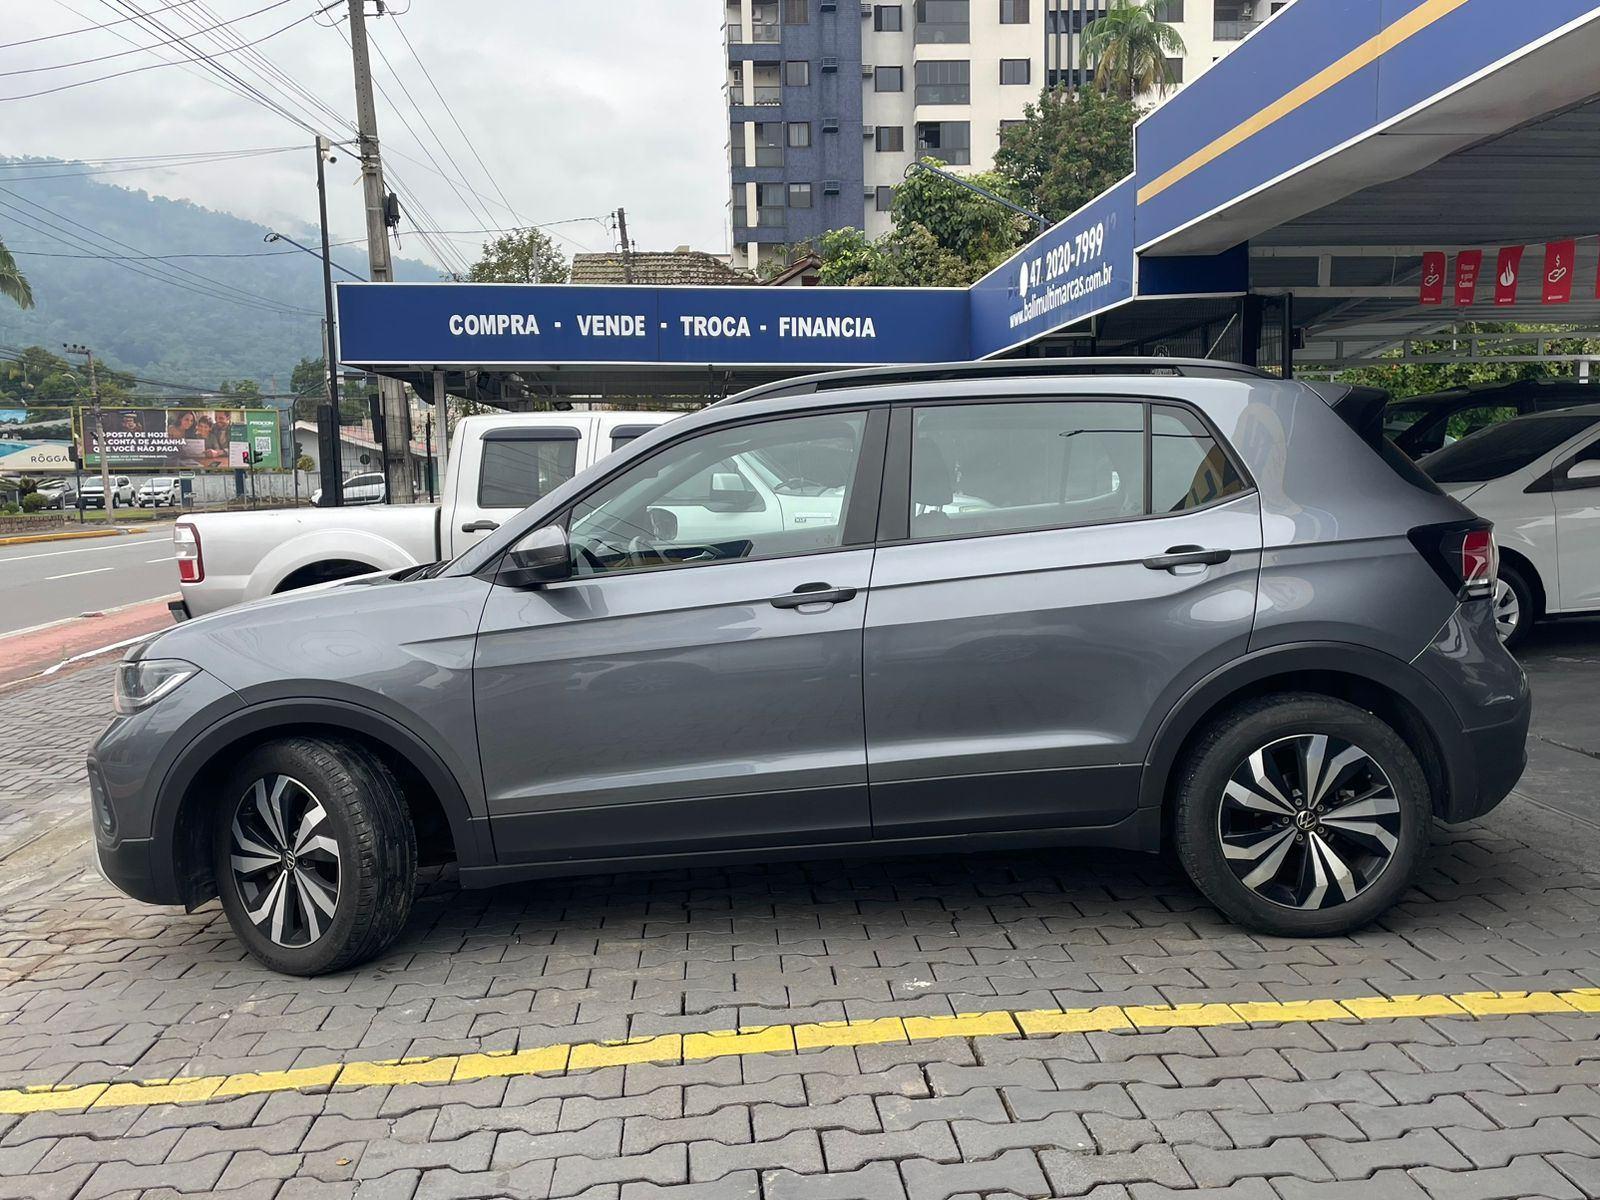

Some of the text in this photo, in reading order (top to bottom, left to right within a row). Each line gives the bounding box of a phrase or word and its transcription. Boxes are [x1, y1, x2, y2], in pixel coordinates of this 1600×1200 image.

[1046, 222, 1104, 281] 2020-7999
[1009, 262, 1113, 329] www.balimultimarcas.com.br
[449, 314, 876, 338] COMPRA VENDE TROCA FINANCIA
[112, 444, 135, 452] VOCÊ
[137, 444, 156, 452] NÃO
